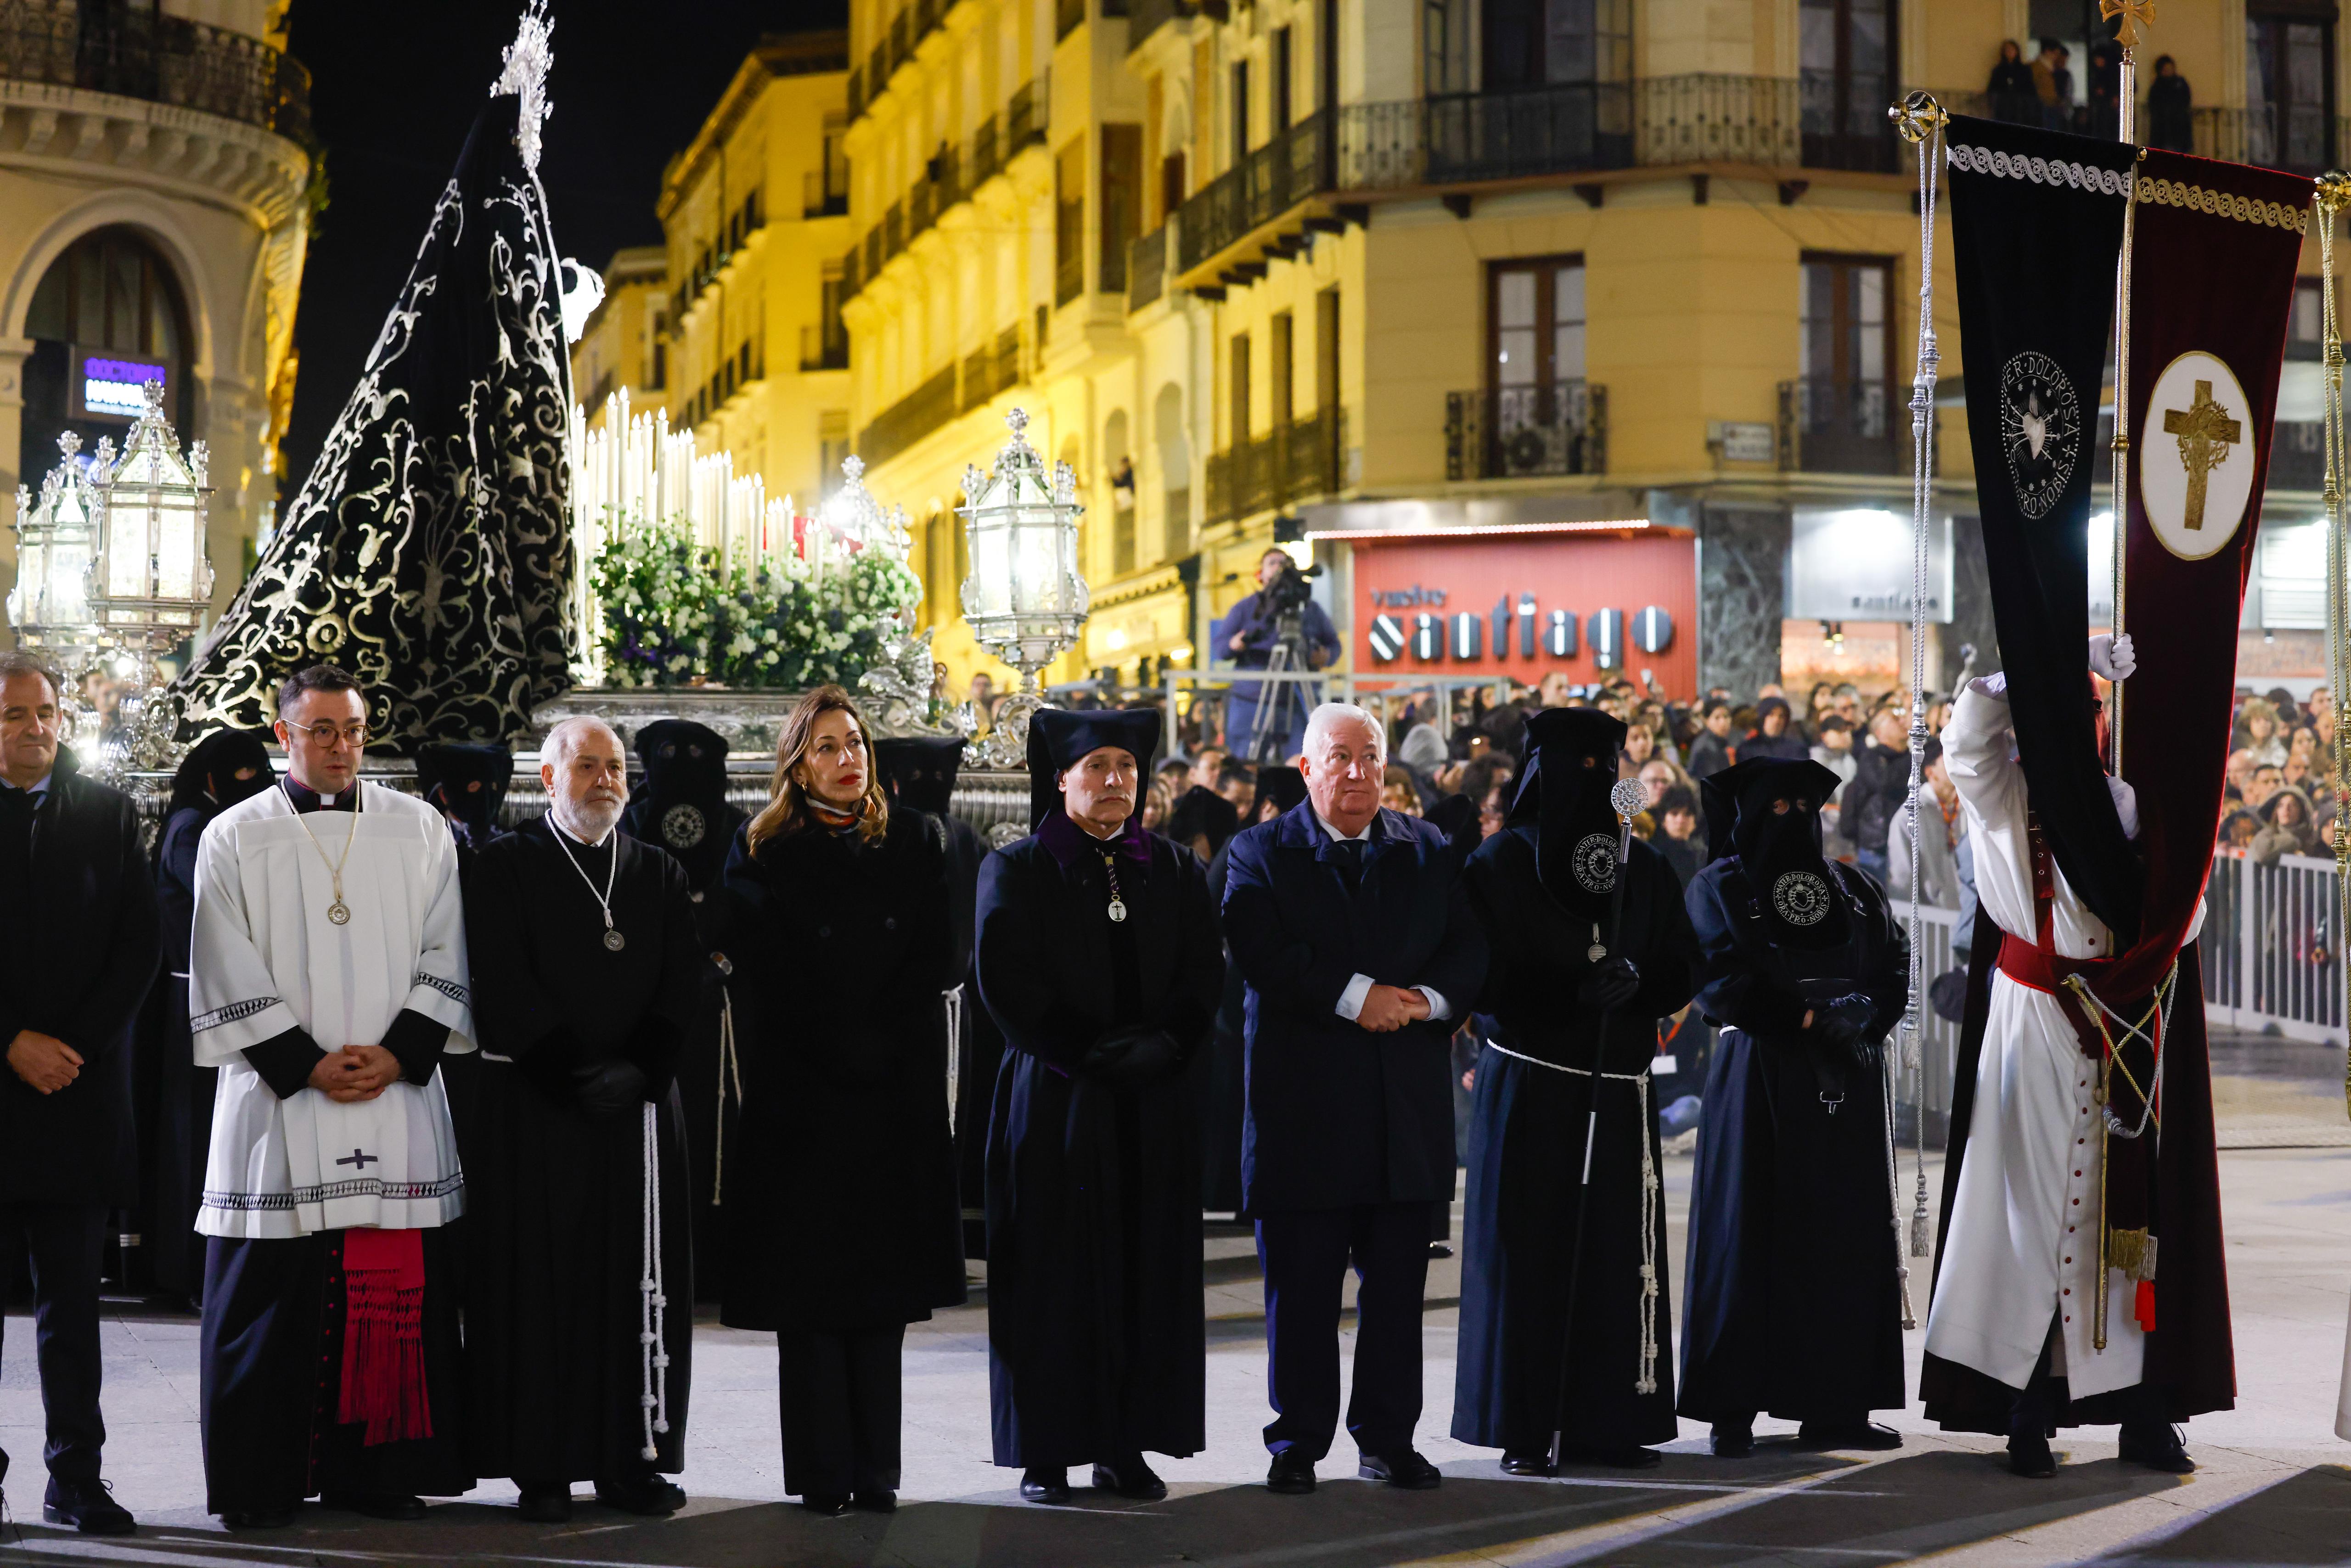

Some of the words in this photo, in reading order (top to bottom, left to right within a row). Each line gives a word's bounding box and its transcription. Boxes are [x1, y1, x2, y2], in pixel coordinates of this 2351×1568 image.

[2028, 357, 2079, 437] DOLOROSA
[2039, 460, 2070, 513] NOBIS
[1368, 591, 1672, 669] santiago
[1577, 837, 1596, 856] MATER
[1575, 863, 1585, 879] ORA
[1583, 879, 1599, 890] PRO
[1775, 876, 1792, 895] MATER
[1791, 873, 1826, 895] DOLOROSA
[1777, 901, 1789, 916] ORA
[1789, 914, 1806, 923] PRO
[1809, 902, 1827, 922] NOBIS
